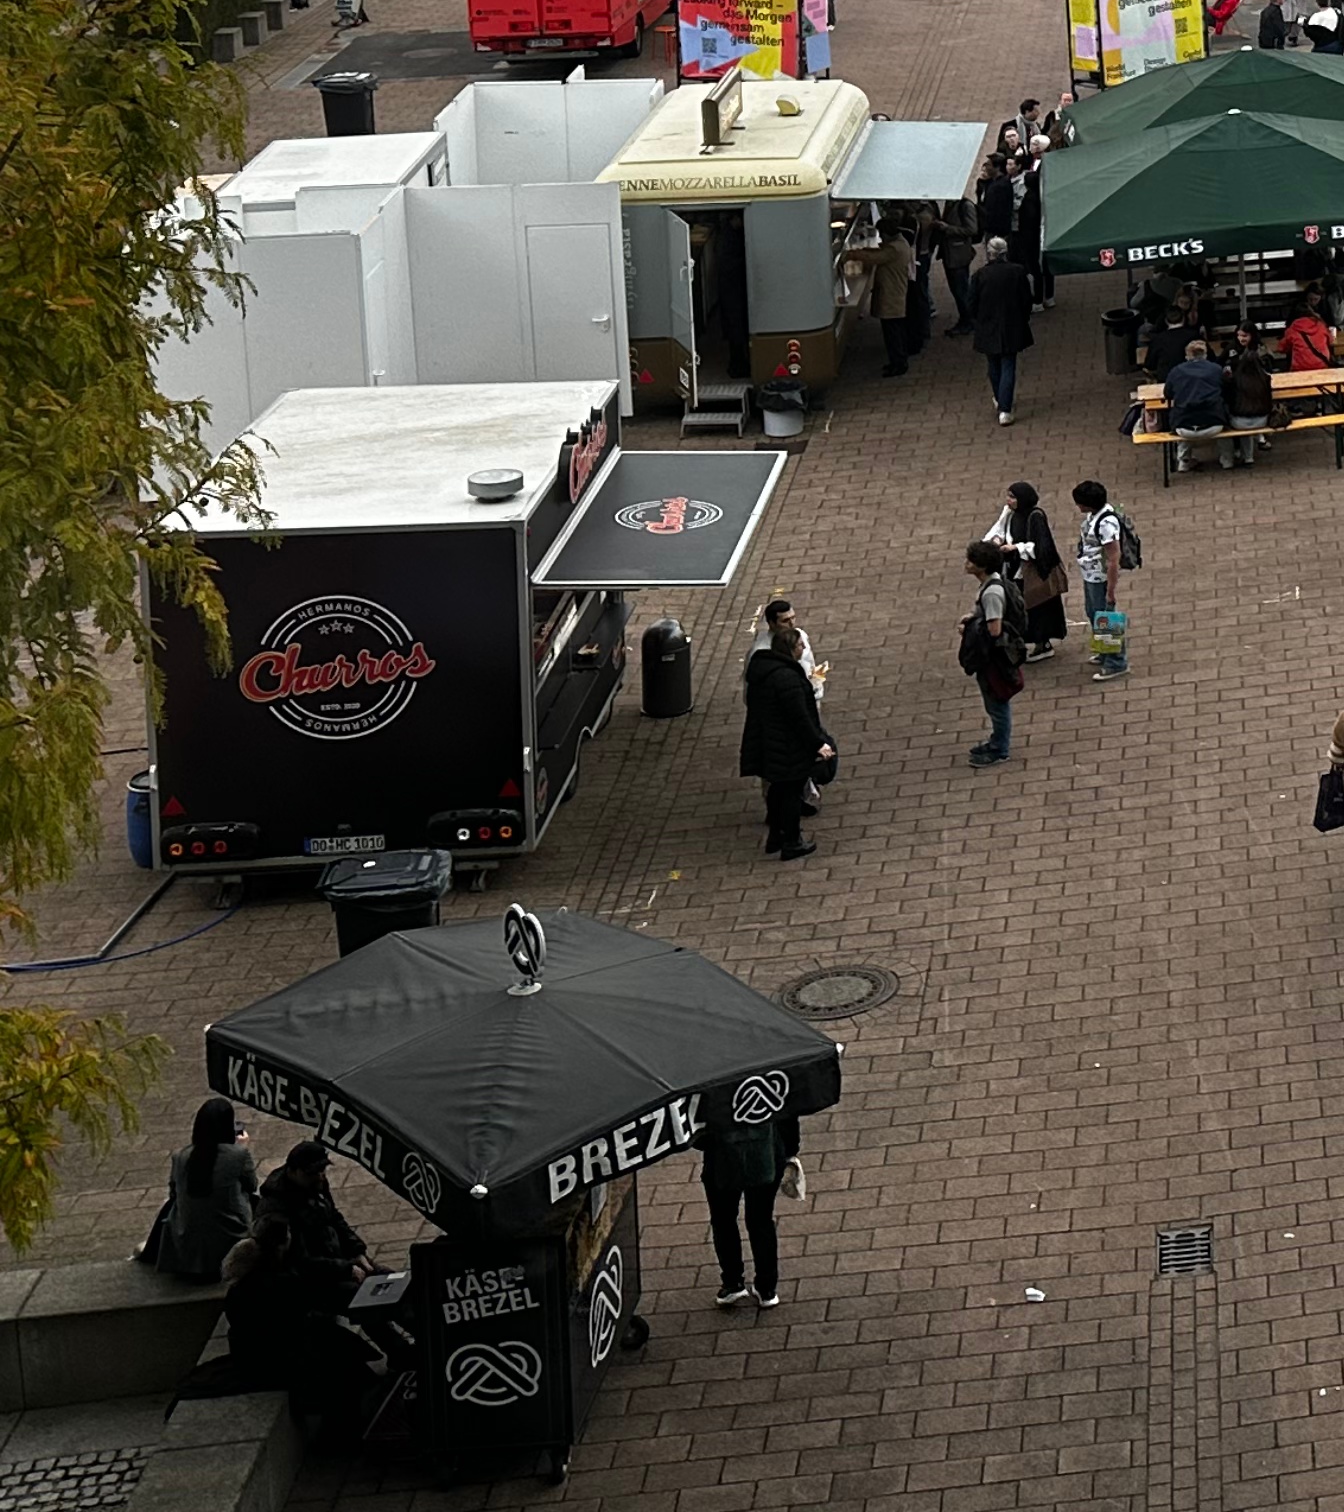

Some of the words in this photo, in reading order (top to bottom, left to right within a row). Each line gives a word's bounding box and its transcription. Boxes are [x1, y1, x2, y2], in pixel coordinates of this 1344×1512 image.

[722, 8, 744, 22] das
[746, 9, 793, 24] Morgen
[730, 34, 785, 47] gestalten
[1127, 238, 1205, 262] BECK'S
[297, 602, 371, 621] HERMANOS
[239, 642, 436, 703] Churros
[304, 714, 378, 732] HERMANOS
[335, 838, 351, 850] HC
[548, 1092, 707, 1205] BREZEL
[445, 1266, 524, 1300] KÄSE-
[442, 1287, 541, 1325] BREZEL
